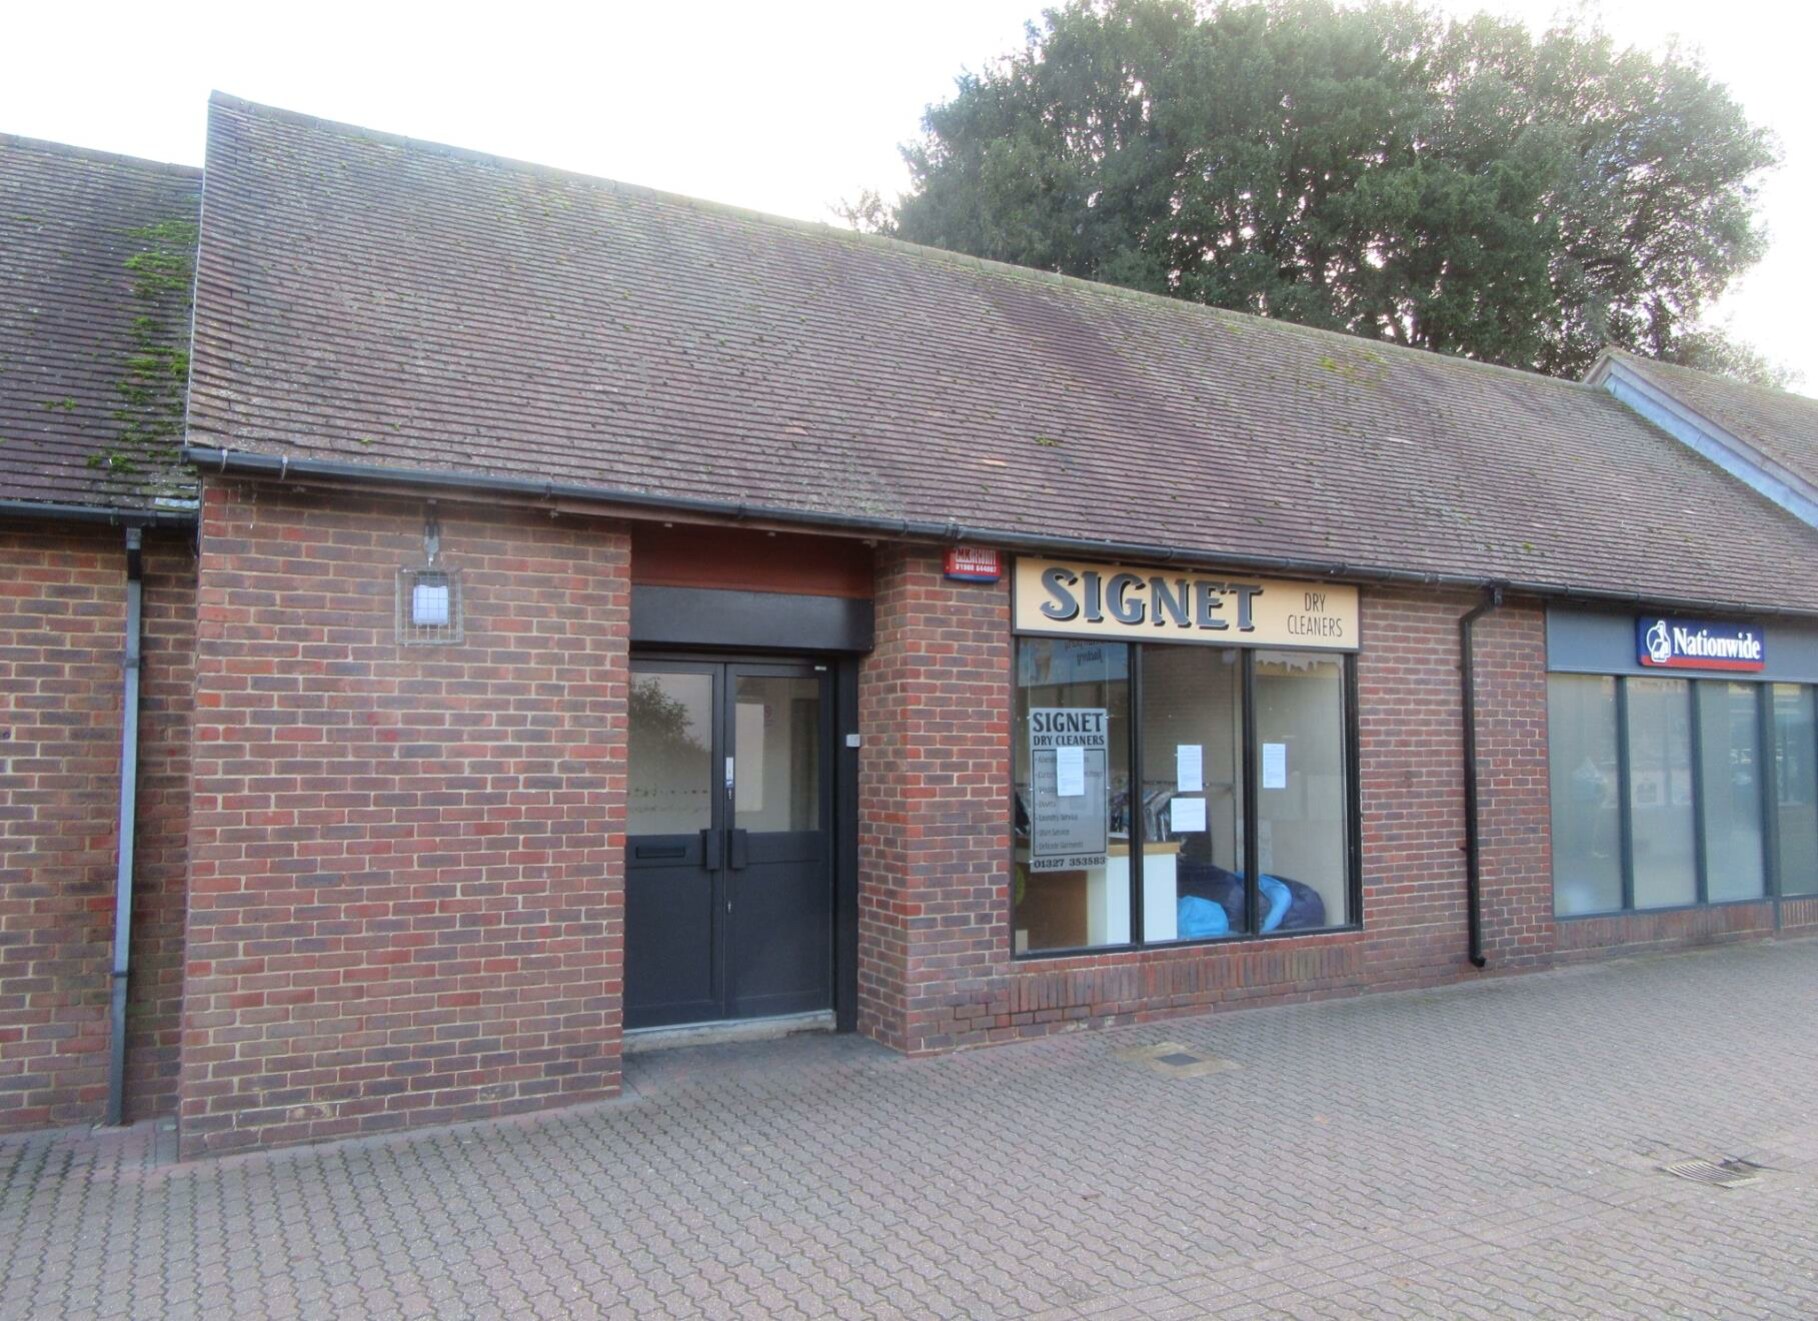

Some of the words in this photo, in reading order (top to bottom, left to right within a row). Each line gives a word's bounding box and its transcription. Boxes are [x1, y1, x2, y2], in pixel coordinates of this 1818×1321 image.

[1040, 566, 1263, 633] SIGNET
[1304, 592, 1327, 614] DRY
[1287, 613, 1344, 638] CLEANERS
[1673, 627, 1761, 660] Nationwide
[1033, 712, 1104, 733] SIGNET
[1033, 736, 1053, 747] DRY
[1055, 735, 1105, 747] CLEANERS
[1033, 858, 1065, 869] 01327
